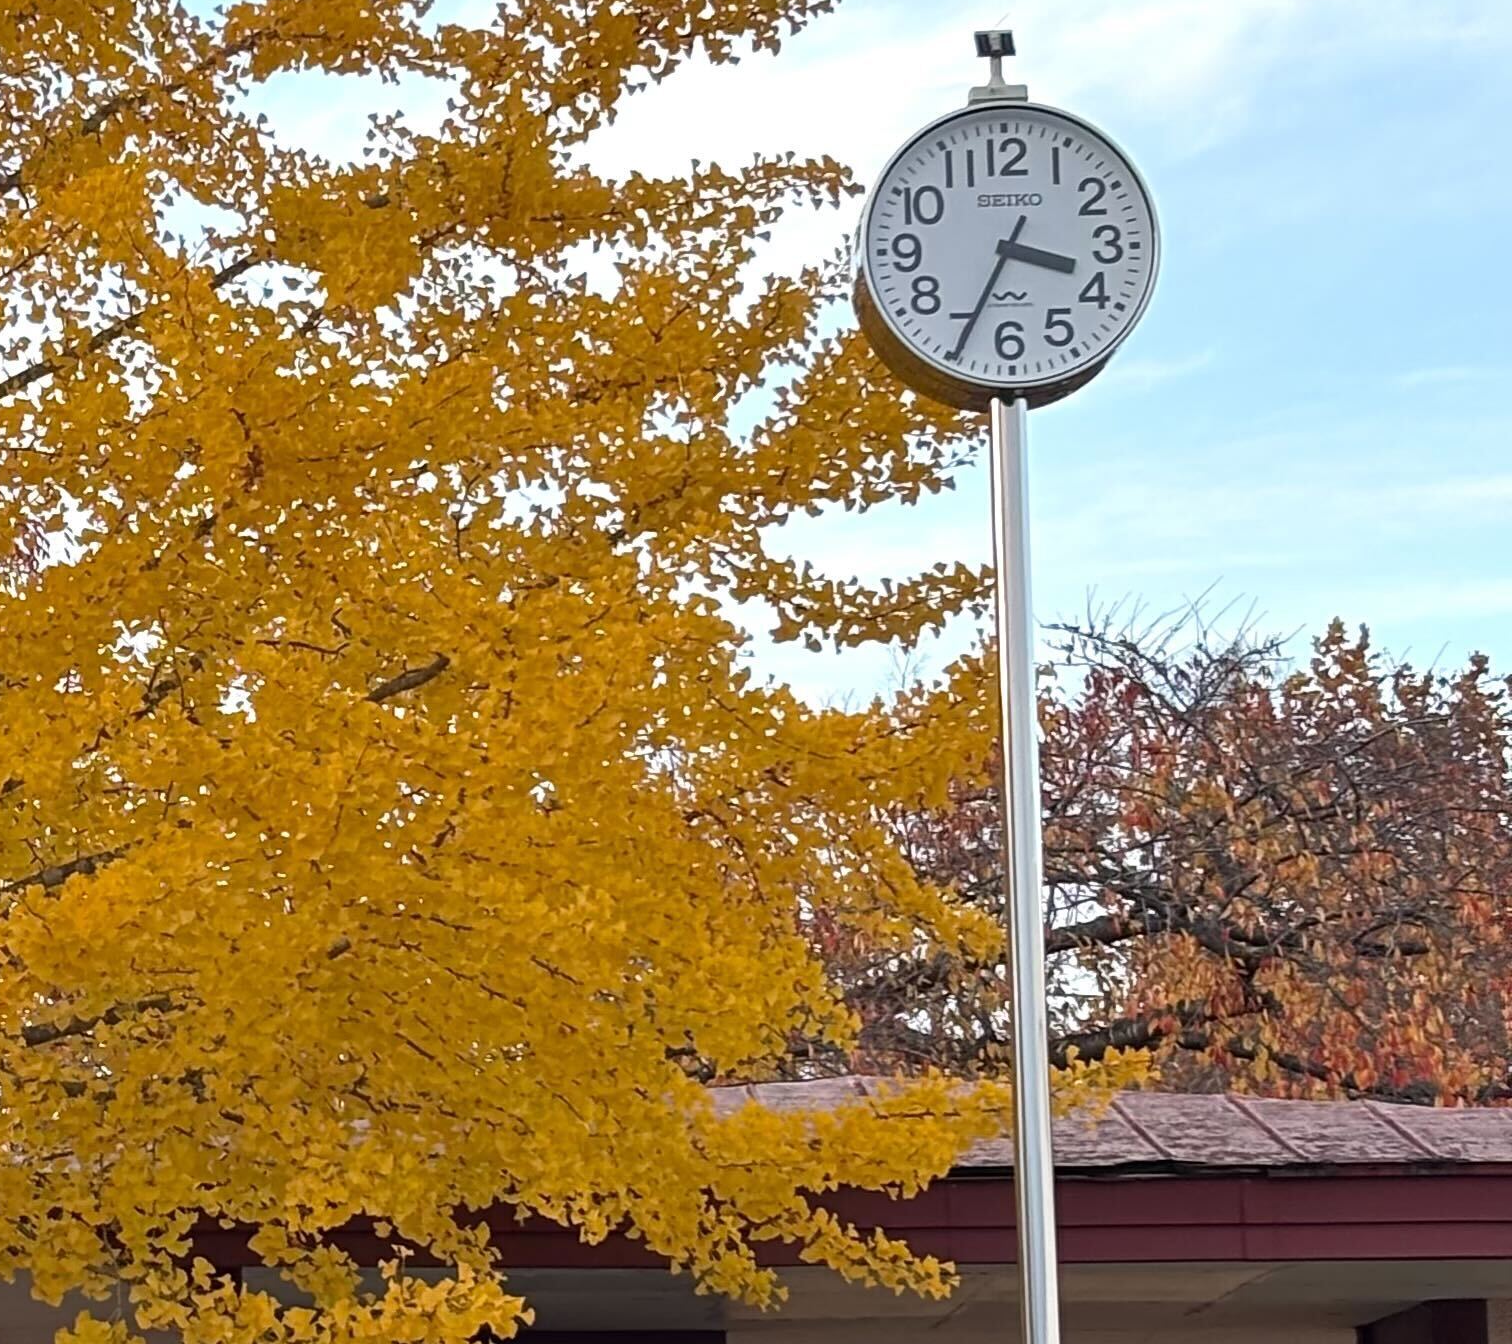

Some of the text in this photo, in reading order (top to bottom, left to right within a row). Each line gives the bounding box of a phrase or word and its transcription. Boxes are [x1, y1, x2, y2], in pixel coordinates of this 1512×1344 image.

[945, 149, 975, 188] 11
[987, 138, 1028, 177] 12
[1051, 147, 1060, 185] 1
[904, 185, 944, 225] 10
[977, 193, 1042, 207] SEIKO
[1077, 178, 1107, 216] 2
[891, 233, 922, 273] 9
[1092, 224, 1124, 264] 3
[910, 276, 941, 315] 8
[1078, 271, 1110, 309] 4
[994, 321, 1025, 361] 6
[1043, 308, 1075, 346] 5
